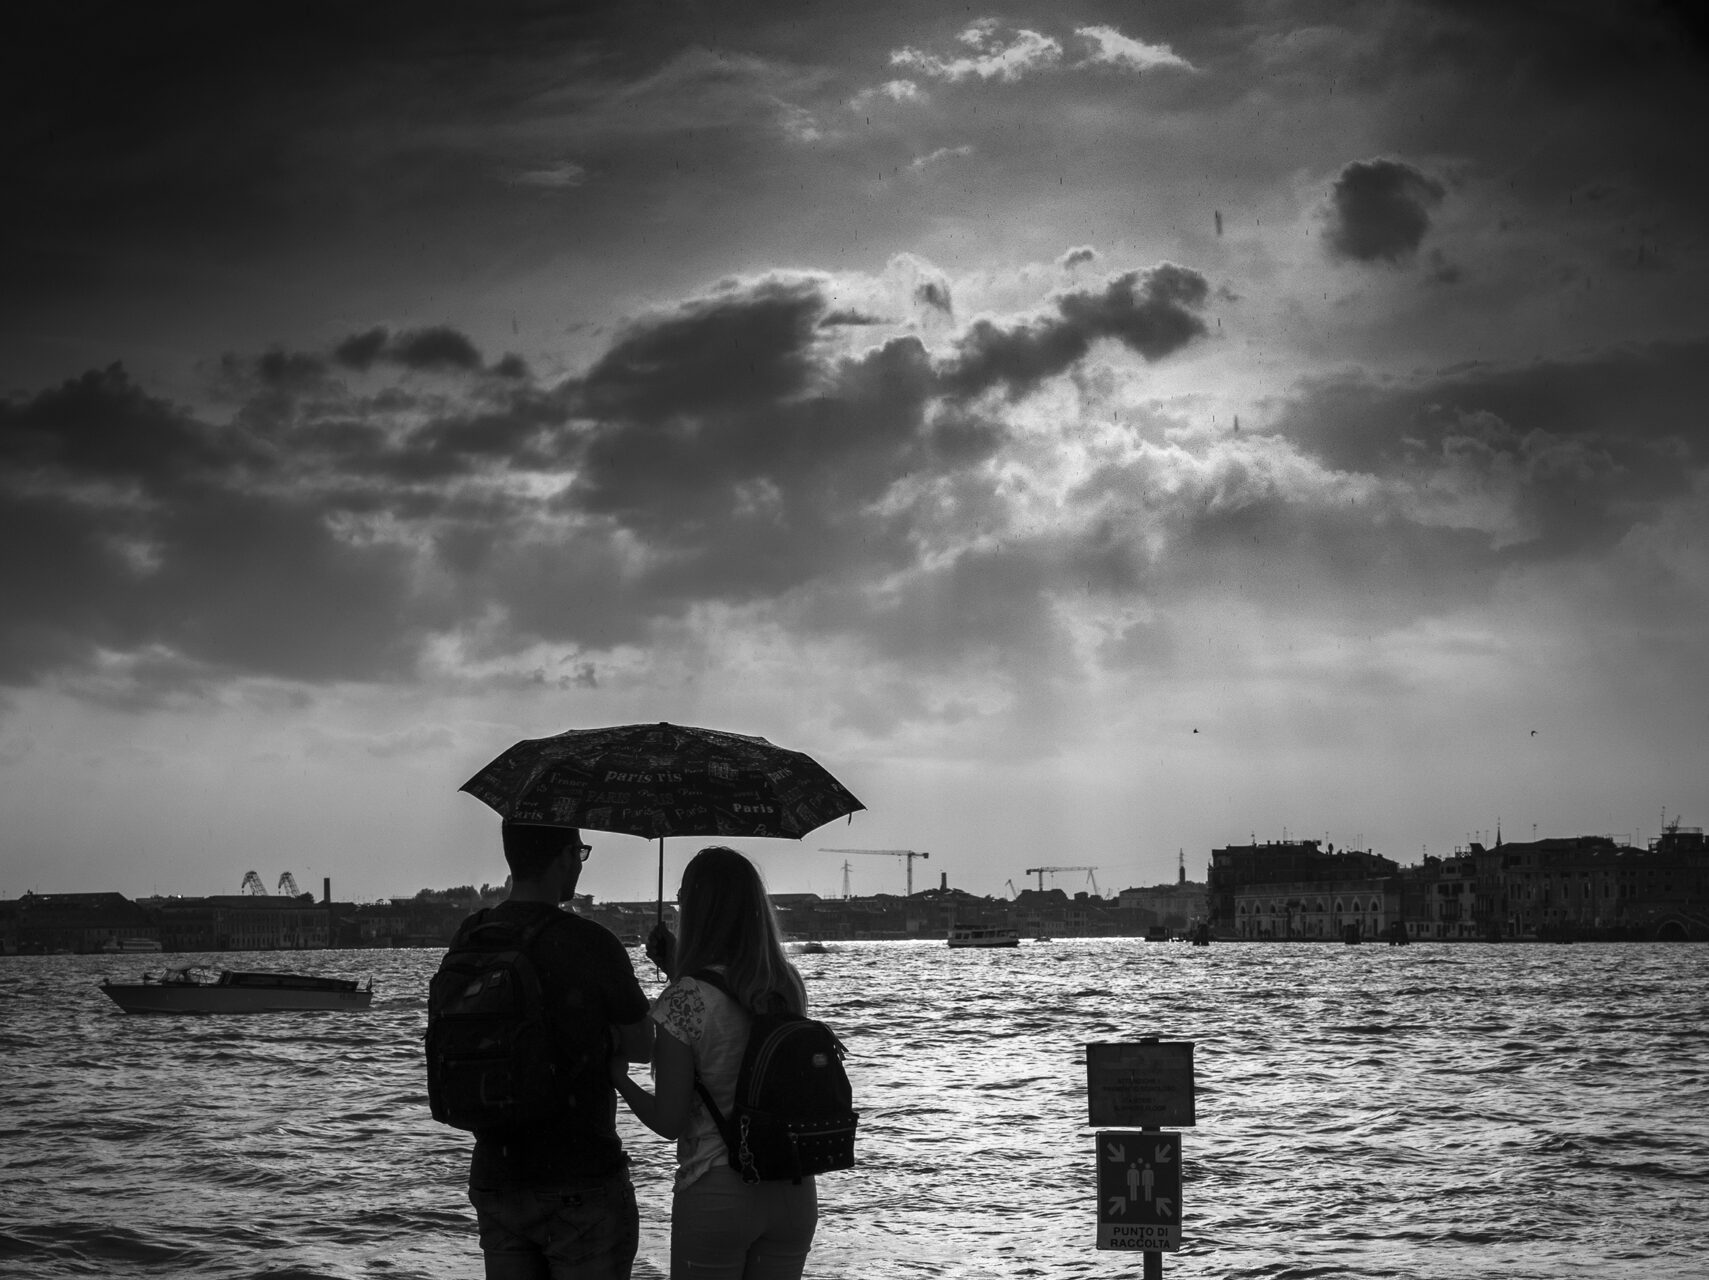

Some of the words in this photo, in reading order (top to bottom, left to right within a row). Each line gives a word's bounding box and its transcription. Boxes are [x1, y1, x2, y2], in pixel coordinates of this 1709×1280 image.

[604, 770, 652, 784] paris
[732, 802, 774, 814] Paris
[1113, 1226, 1154, 1237] PUNTO
[1157, 1227, 1168, 1237] DI
[1110, 1238, 1170, 1248] RACCOLTA
